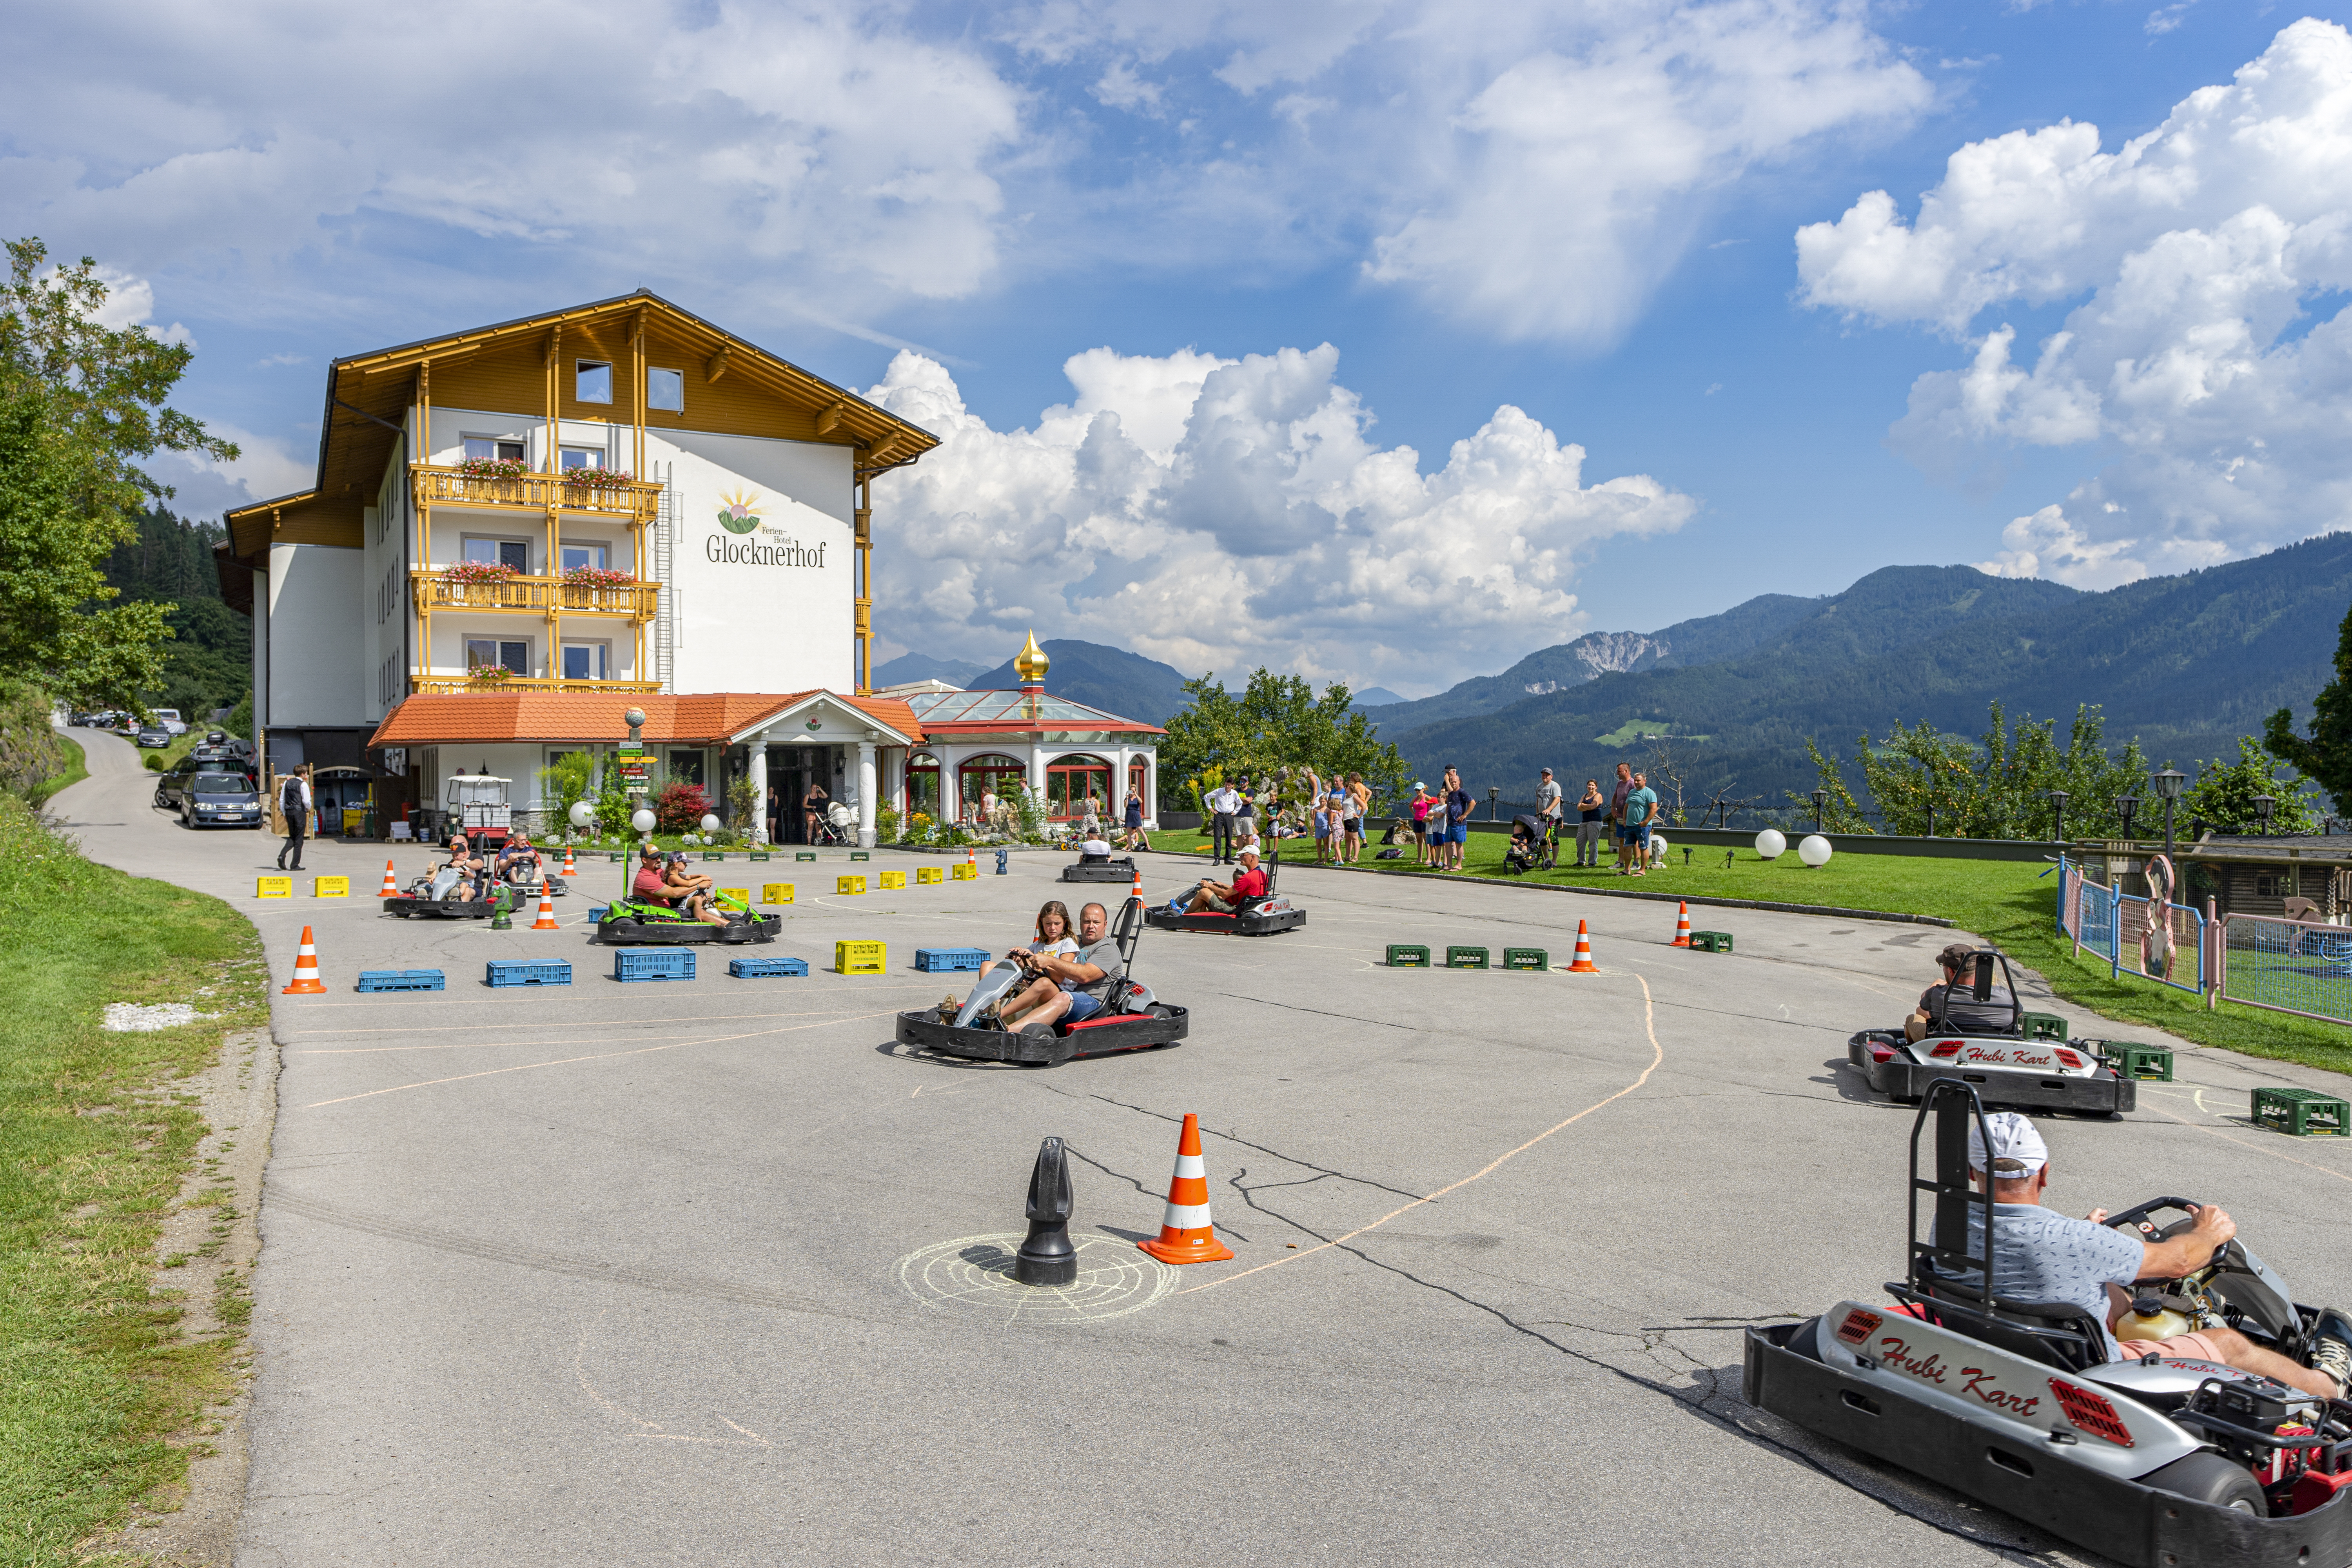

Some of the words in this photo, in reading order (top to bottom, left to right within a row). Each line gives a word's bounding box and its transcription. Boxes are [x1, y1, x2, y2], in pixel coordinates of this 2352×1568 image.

[762, 526, 787, 535] Ferien-
[774, 536, 791, 544] Hotel
[706, 535, 826, 568] Glocknerhof
[1967, 1047, 2006, 1062] Hubi
[2013, 1051, 2050, 1065] Kart
[1881, 1338, 1947, 1383] Hubi
[1961, 1367, 2040, 1417] Kart
